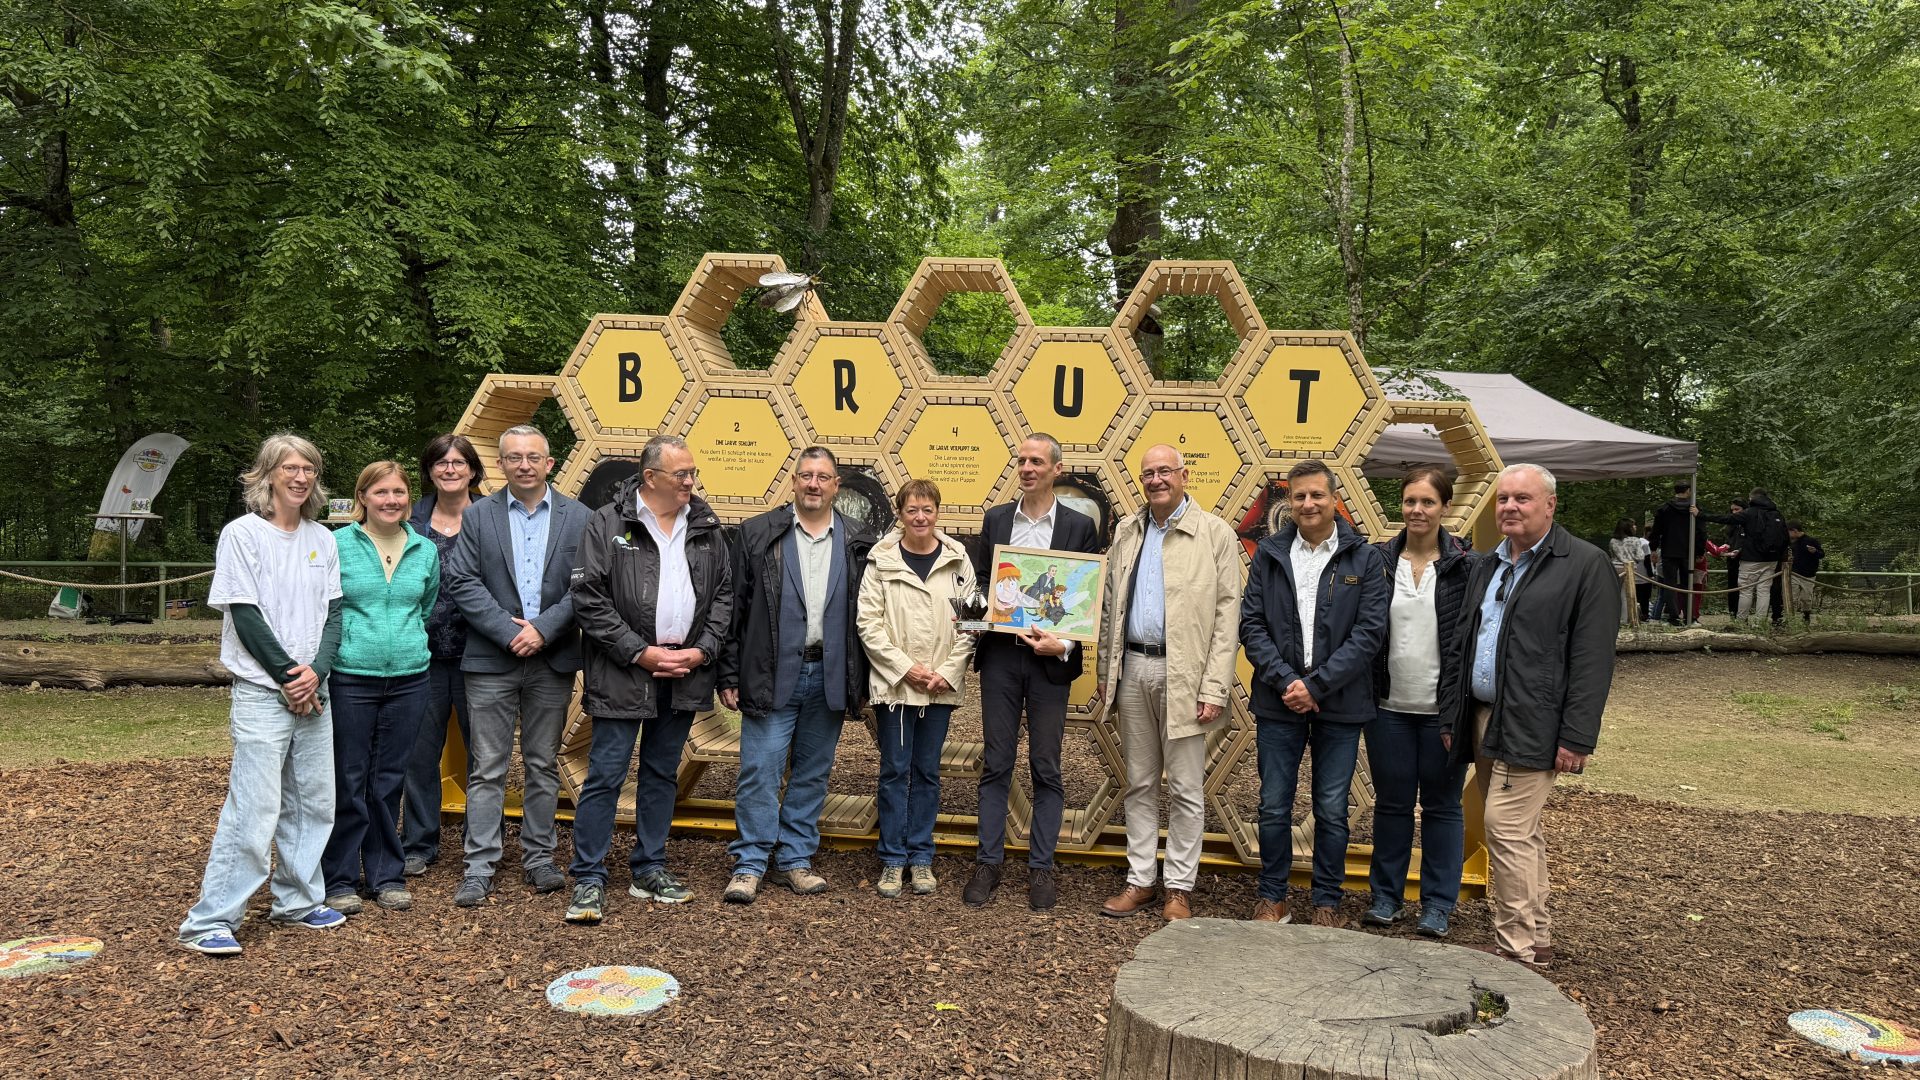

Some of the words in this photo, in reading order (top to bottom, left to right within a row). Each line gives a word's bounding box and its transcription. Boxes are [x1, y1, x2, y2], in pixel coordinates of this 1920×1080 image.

[618, 352, 642, 402] B
[833, 360, 859, 414] R
[1054, 365, 1083, 417] U
[1290, 370, 1320, 423] T
[734, 422, 740, 432] 2
[952, 426, 958, 437] 4
[1179, 434, 1186, 443] 6
